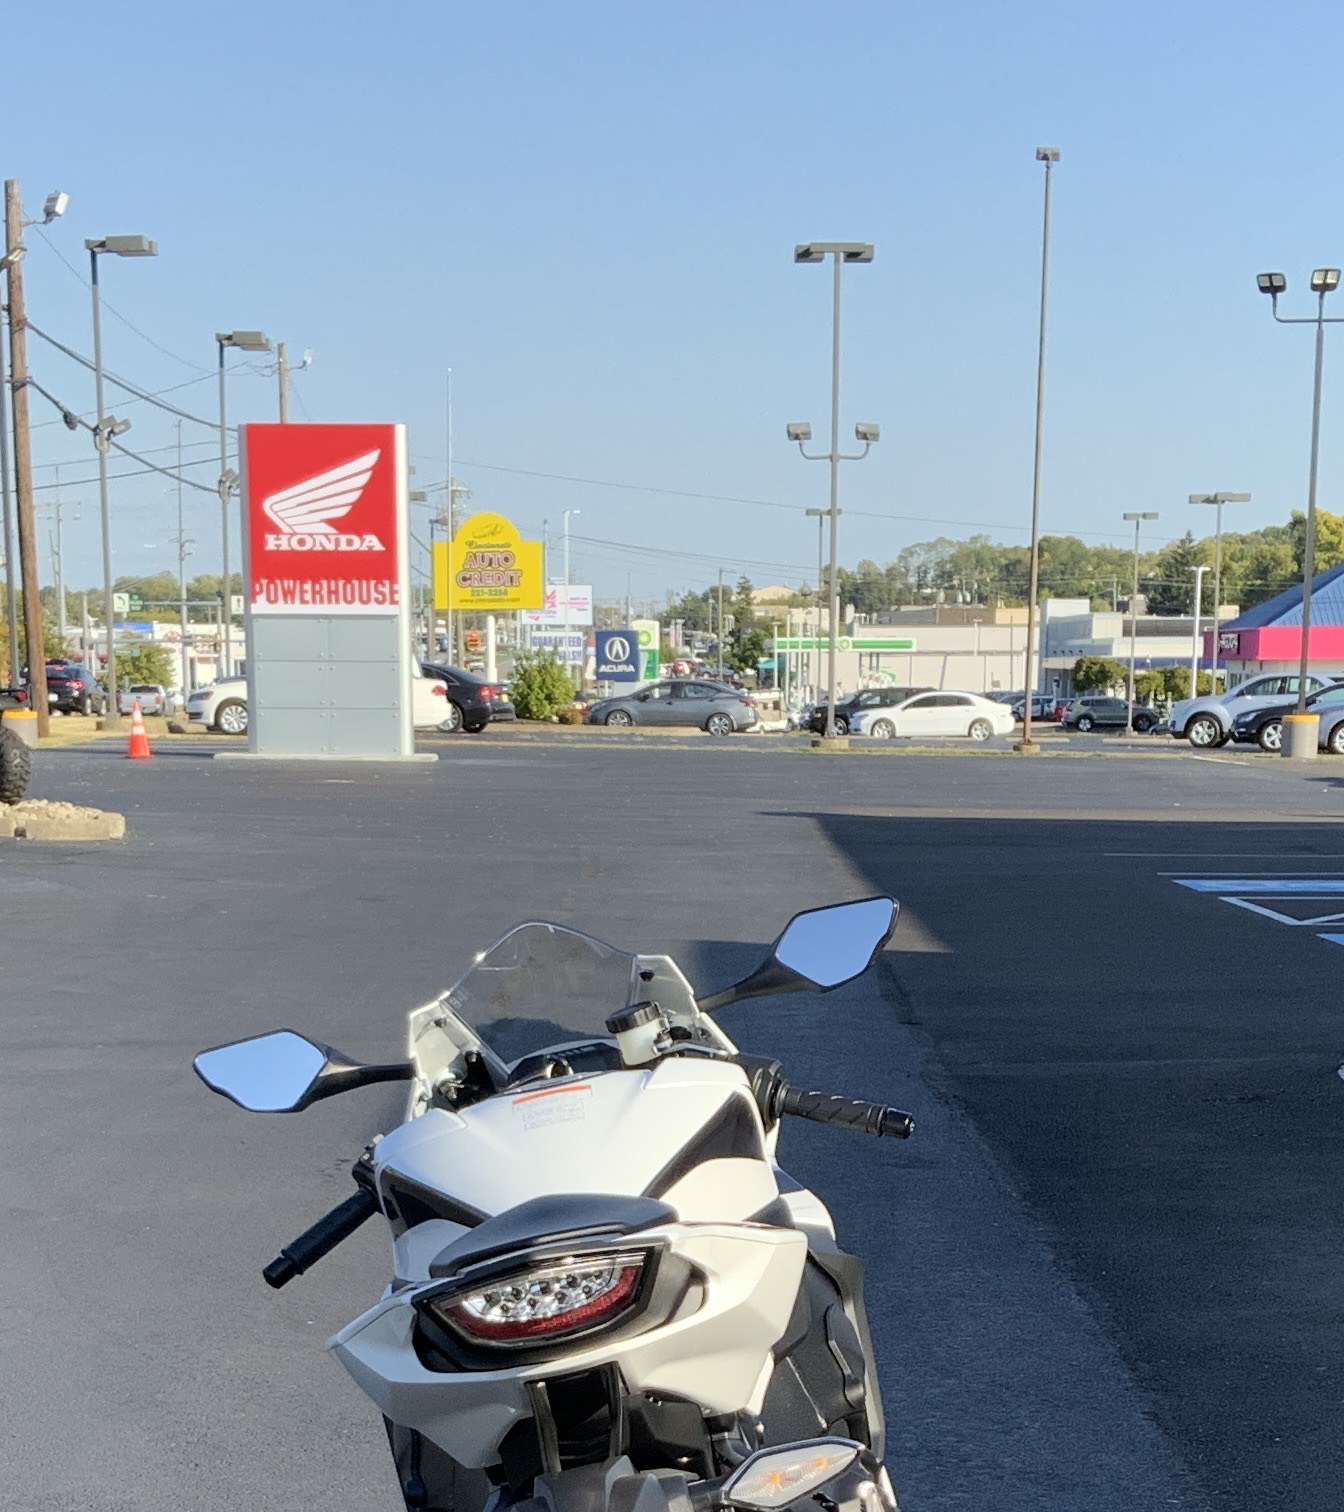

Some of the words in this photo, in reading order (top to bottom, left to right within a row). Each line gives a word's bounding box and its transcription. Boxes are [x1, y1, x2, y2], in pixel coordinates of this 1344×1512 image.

[265, 534, 386, 551] HONDA
[463, 551, 515, 568] AUTO
[456, 569, 522, 588] CREDIT
[250, 579, 399, 605] POWERHOUSE
[599, 664, 635, 673] ACURA
